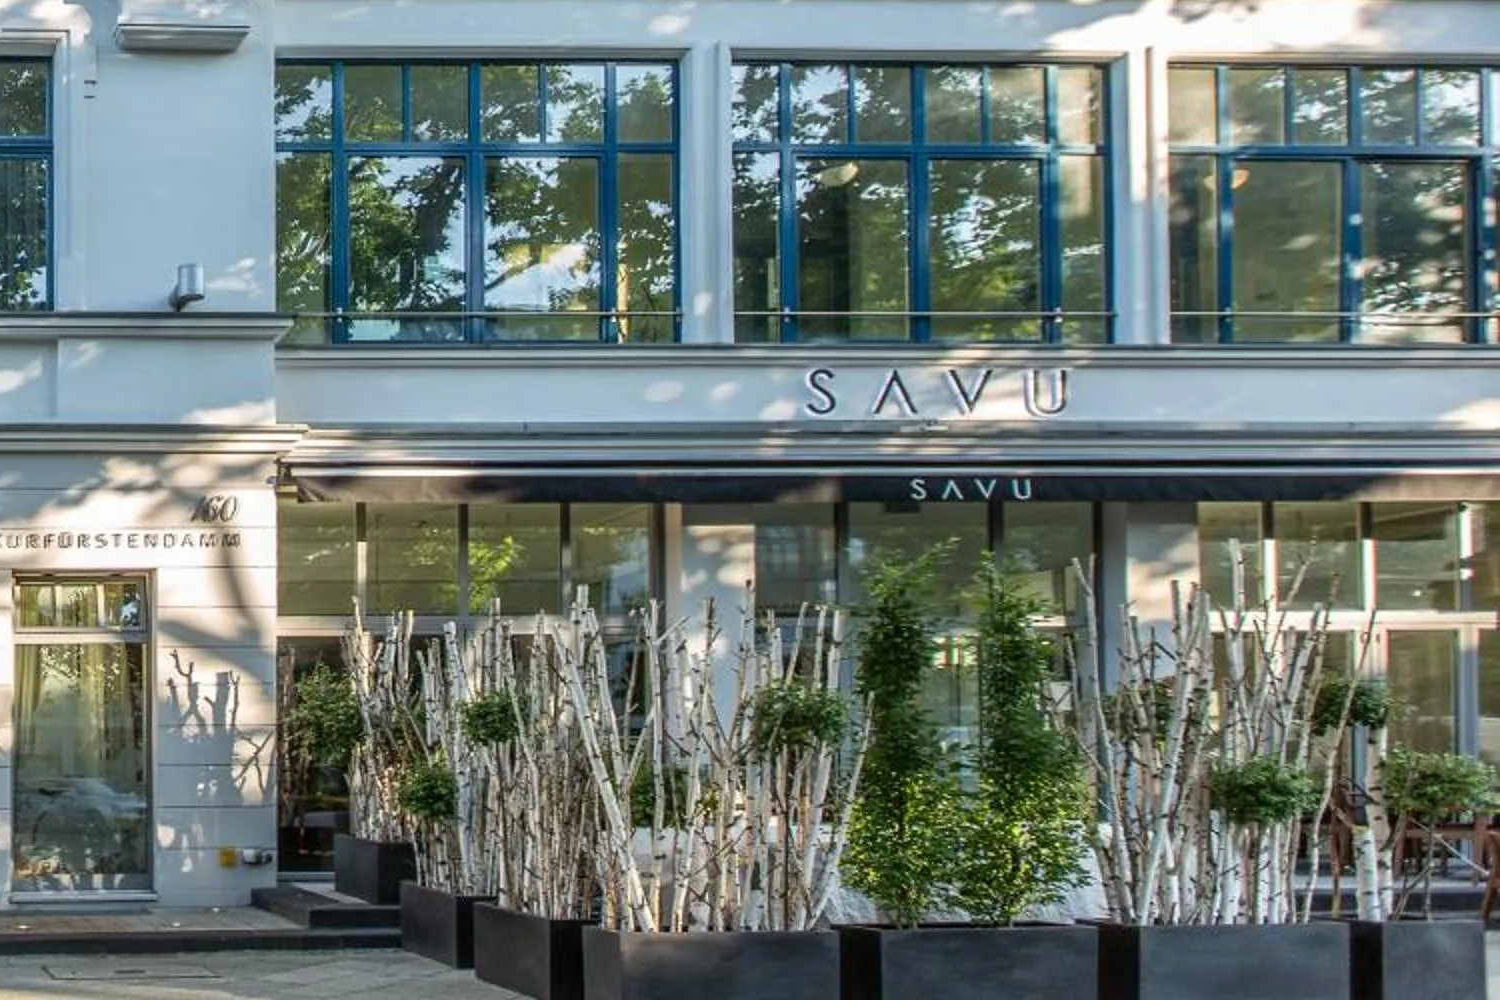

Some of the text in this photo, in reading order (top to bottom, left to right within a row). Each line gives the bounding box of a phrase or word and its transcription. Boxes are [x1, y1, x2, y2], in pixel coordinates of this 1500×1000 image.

[805, 368, 1068, 417] SAVU
[910, 479, 1032, 500] SAVU
[190, 495, 238, 522] 160
